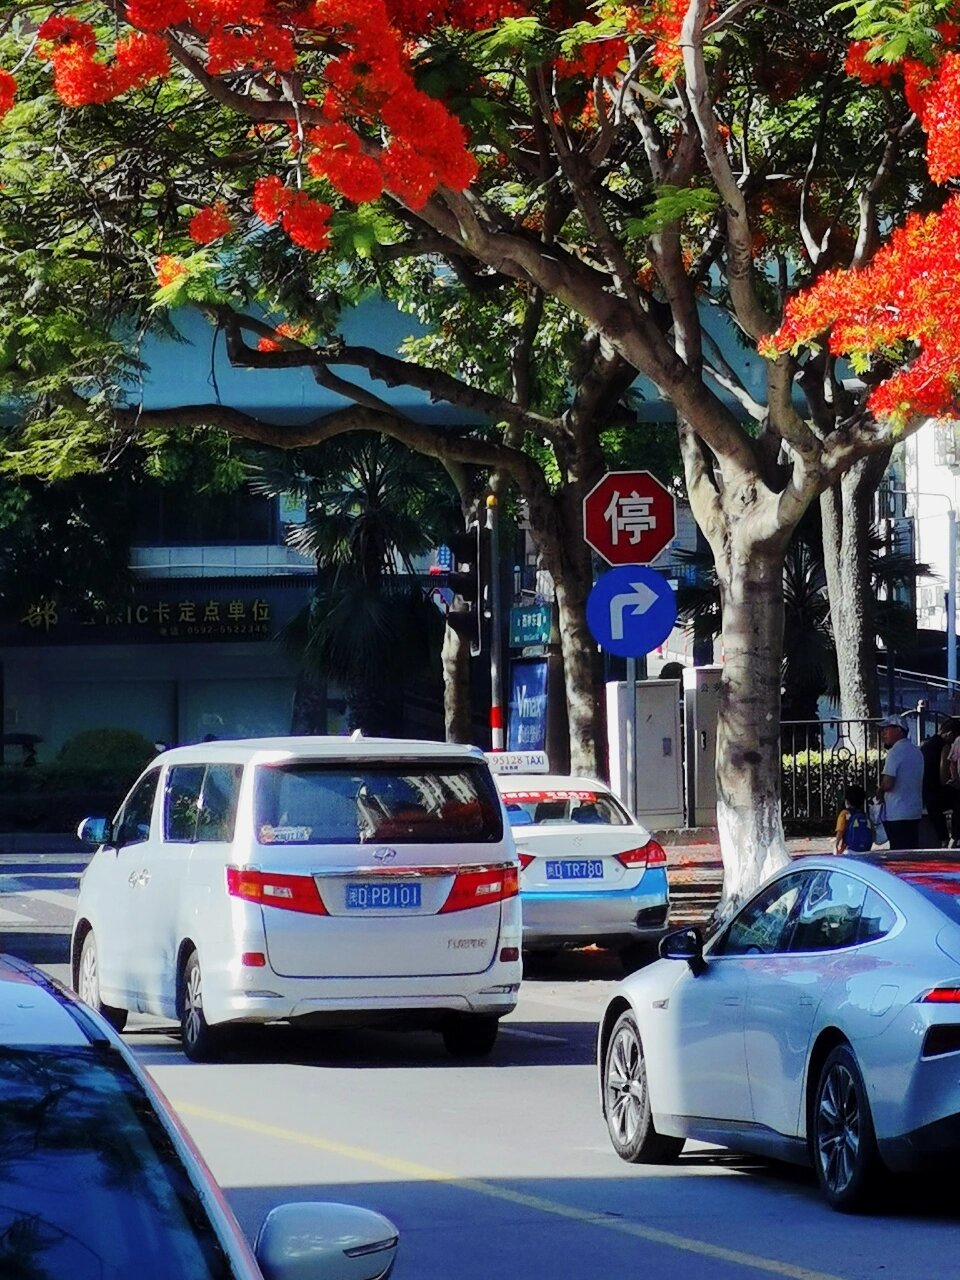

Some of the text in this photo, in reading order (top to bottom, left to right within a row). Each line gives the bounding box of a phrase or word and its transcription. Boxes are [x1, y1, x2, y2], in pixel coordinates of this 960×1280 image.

[604, 490, 656, 545] 停
[516, 685, 542, 718] Vmax
[493, 755, 545, 766] 95128 TAXI
